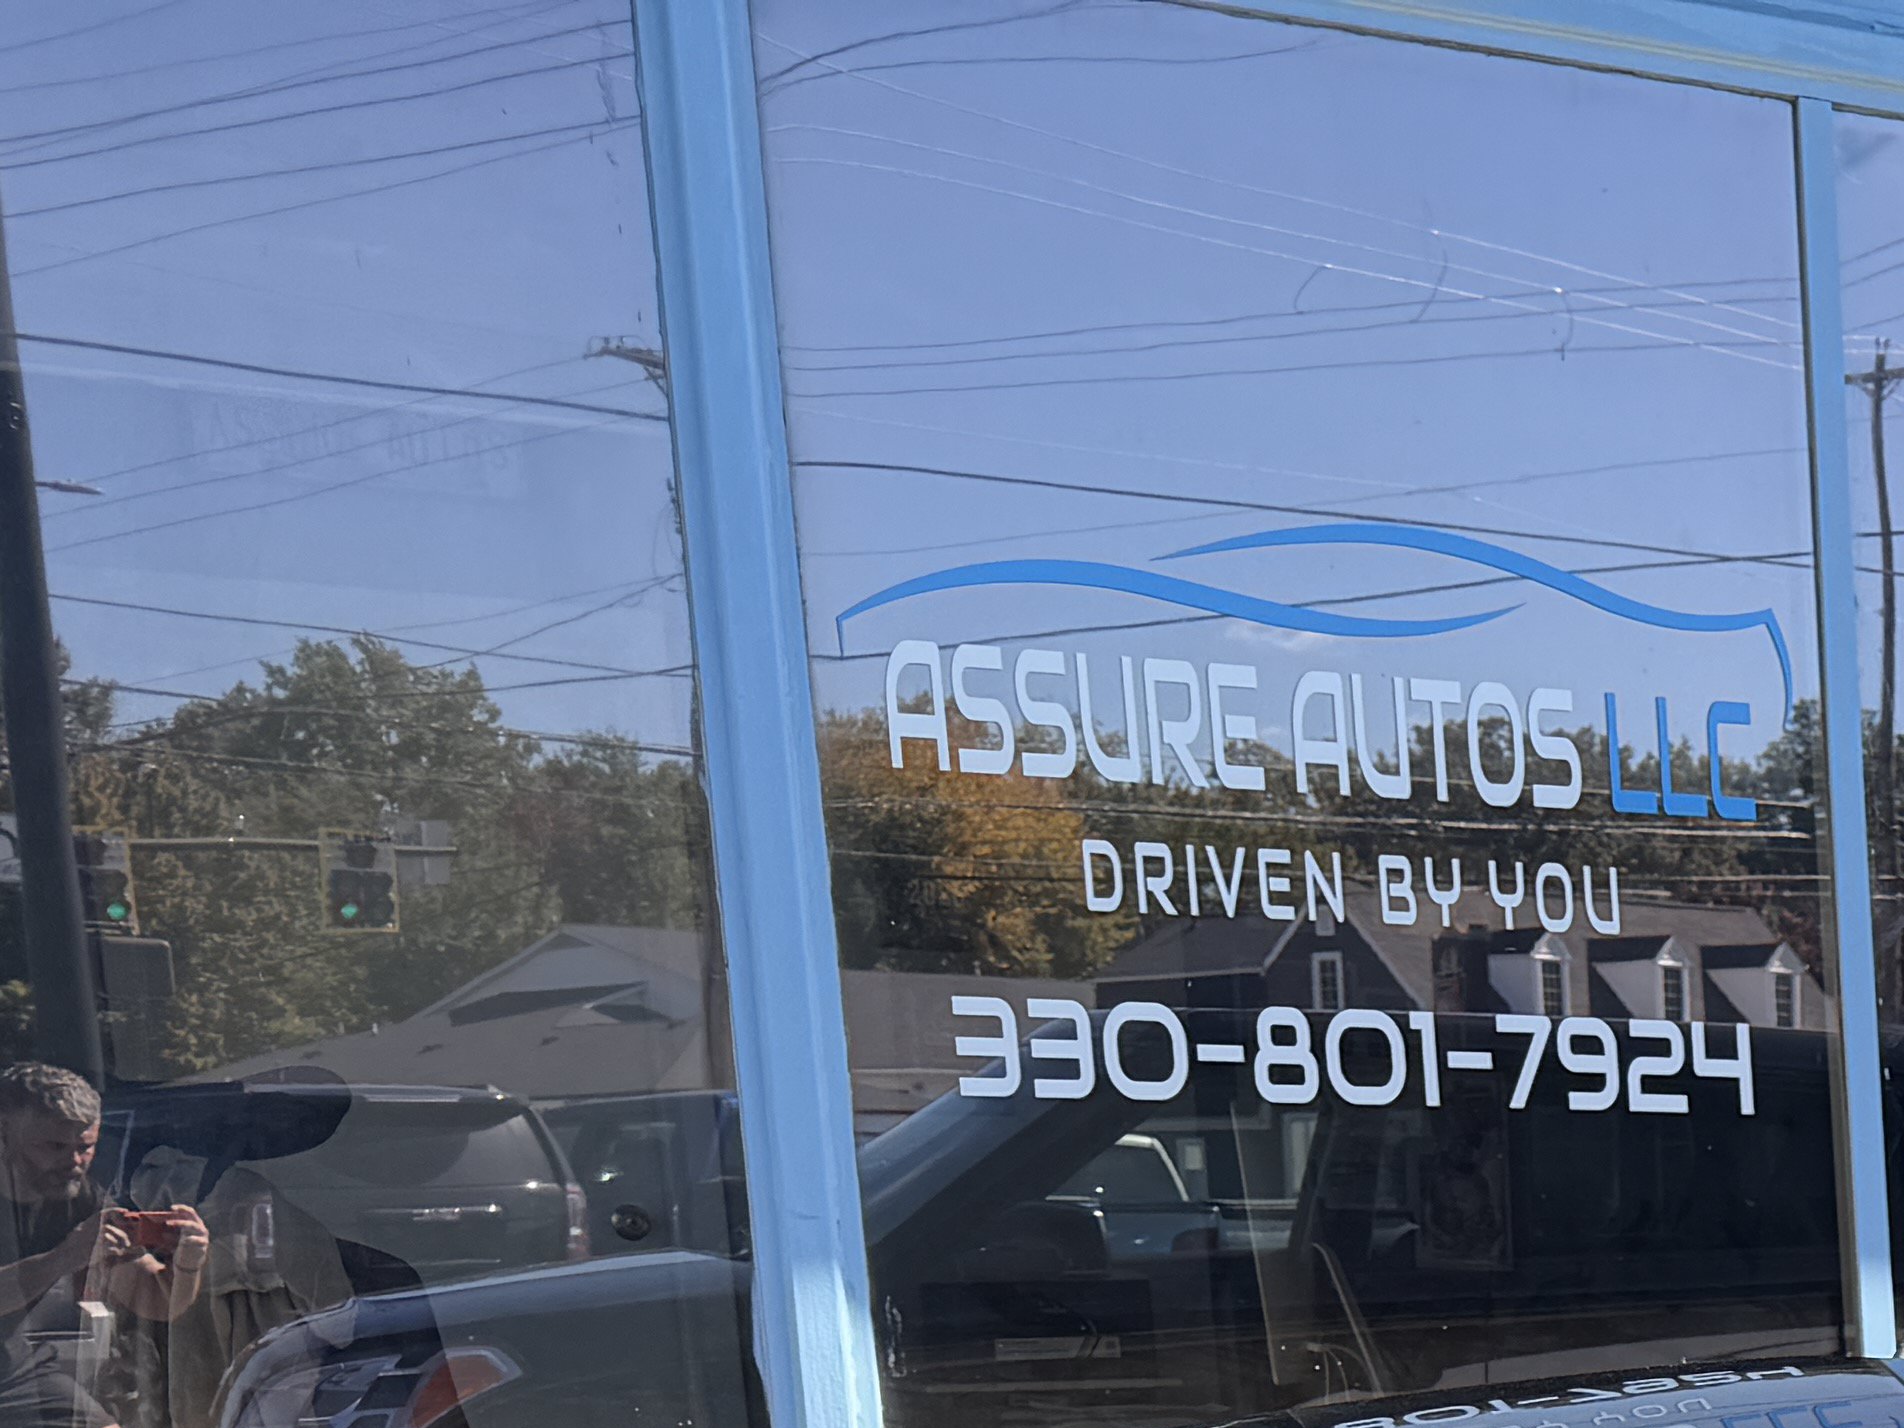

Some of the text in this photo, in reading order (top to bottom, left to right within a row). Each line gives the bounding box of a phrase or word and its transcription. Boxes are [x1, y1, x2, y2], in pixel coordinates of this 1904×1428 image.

[886, 640, 1756, 822] ASSURE AUTOS LLC
[1083, 840, 1620, 935] DRIVEN BY YOU
[951, 995, 1755, 1117] 330-801-7924
